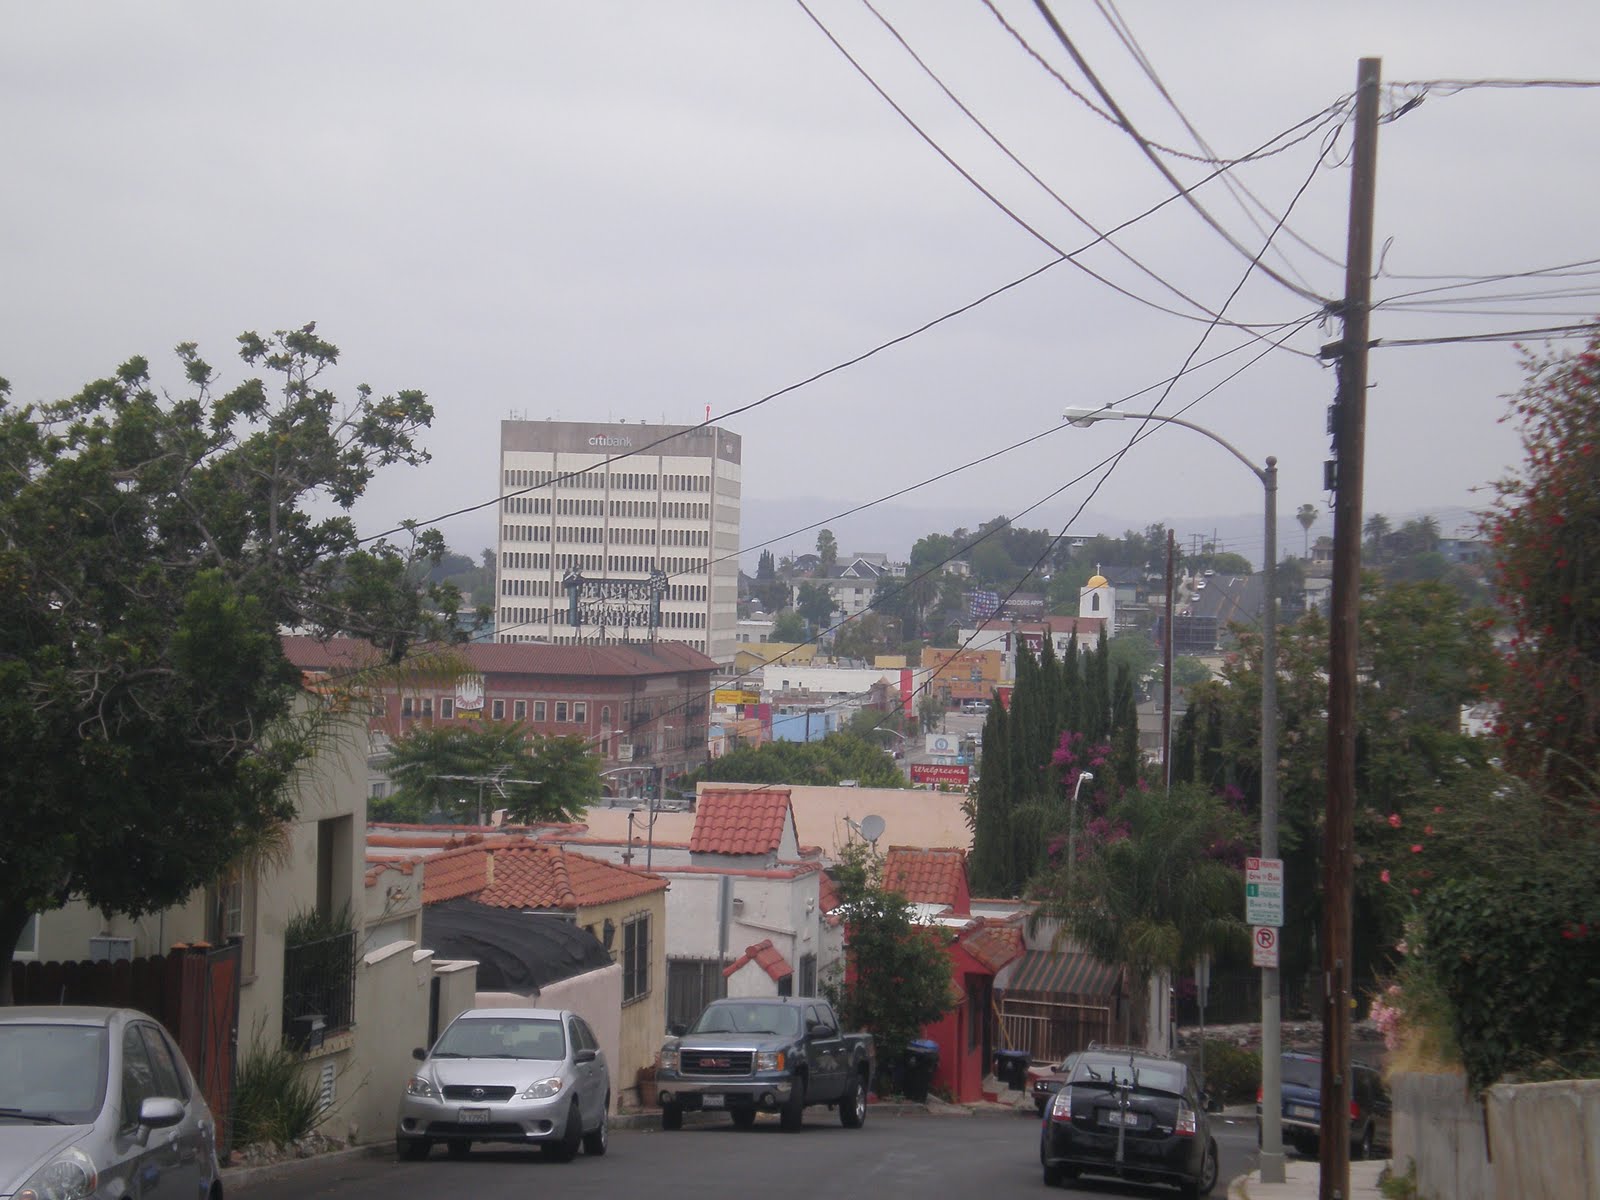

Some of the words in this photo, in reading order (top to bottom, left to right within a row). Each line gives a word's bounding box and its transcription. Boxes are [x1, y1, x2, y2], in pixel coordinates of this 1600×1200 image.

[588, 435, 632, 447] citibank
[589, 612, 637, 626] CENTER
[912, 766, 966, 776] Walgreens
[925, 776, 962, 784] PHARMACY
[1247, 859, 1258, 869] NO
[698, 1058, 731, 1068] GMC
